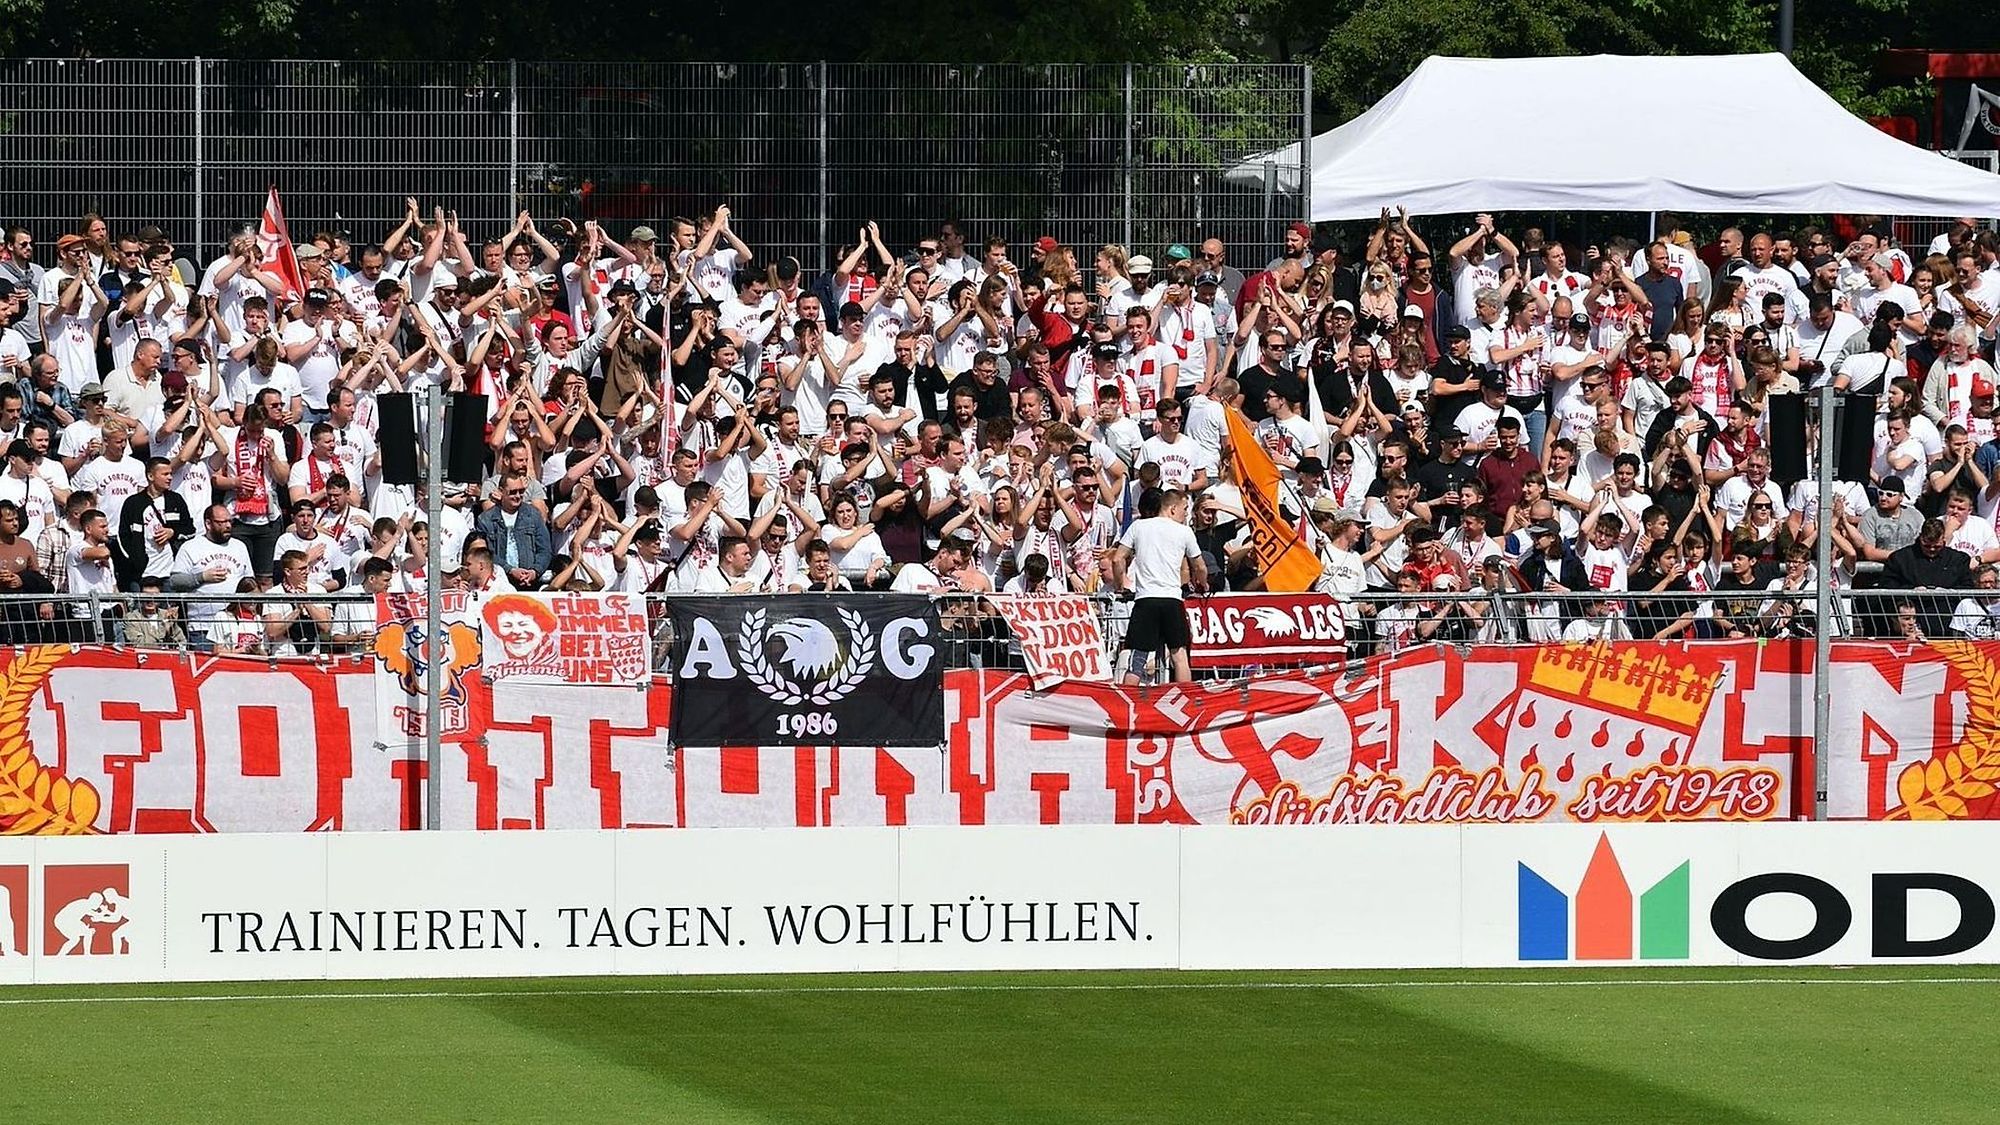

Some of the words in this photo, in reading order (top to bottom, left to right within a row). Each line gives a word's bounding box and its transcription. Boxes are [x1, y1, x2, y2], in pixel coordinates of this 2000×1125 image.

[1161, 454, 1190, 469] FORTUNA
[1164, 468, 1182, 477] KÖLN
[108, 473, 138, 488] FORTUNA
[111, 487, 129, 496] KÖLN
[551, 586, 602, 615] FÜR
[1000, 599, 1090, 622] EKTION
[557, 614, 646, 633] IMMER
[1010, 617, 1100, 650] SDION
[1186, 606, 1246, 645] EAG
[1292, 603, 1346, 641] LES
[560, 634, 603, 658] BEI
[679, 616, 738, 679] A
[880, 616, 936, 681] G
[564, 659, 614, 683] UNS
[775, 711, 838, 739] 1986
[1570, 767, 1668, 820] seit
[1664, 770, 1778, 817] 1948
[202, 908, 541, 953] TRAINIEREN.
[559, 906, 746, 948] TAGEN.
[764, 895, 1153, 946] WOHLFÜHLEN.
